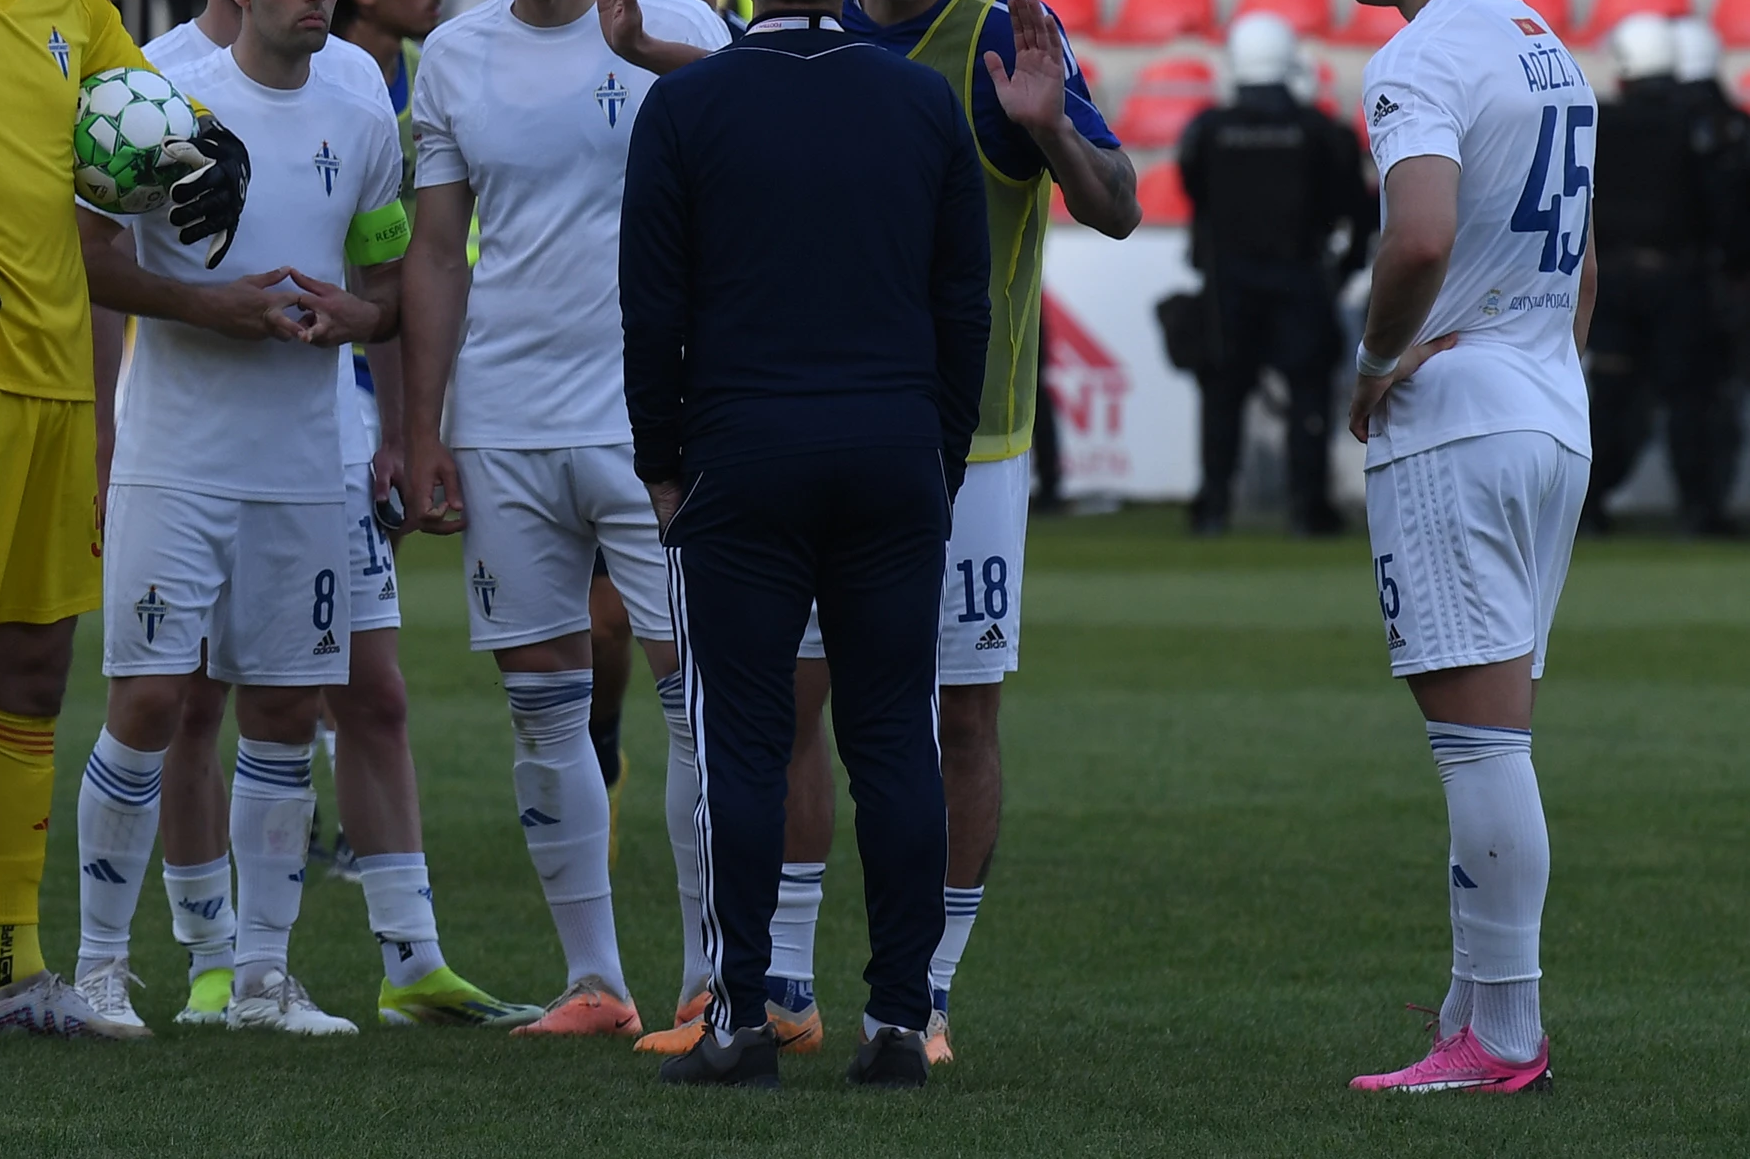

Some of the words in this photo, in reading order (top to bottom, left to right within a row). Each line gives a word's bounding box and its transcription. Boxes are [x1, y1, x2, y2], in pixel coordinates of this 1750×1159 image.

[1510, 105, 1594, 276] 45
[374, 220, 407, 242] RESPEC
[313, 569, 335, 631] 8
[956, 555, 1008, 623] 18
